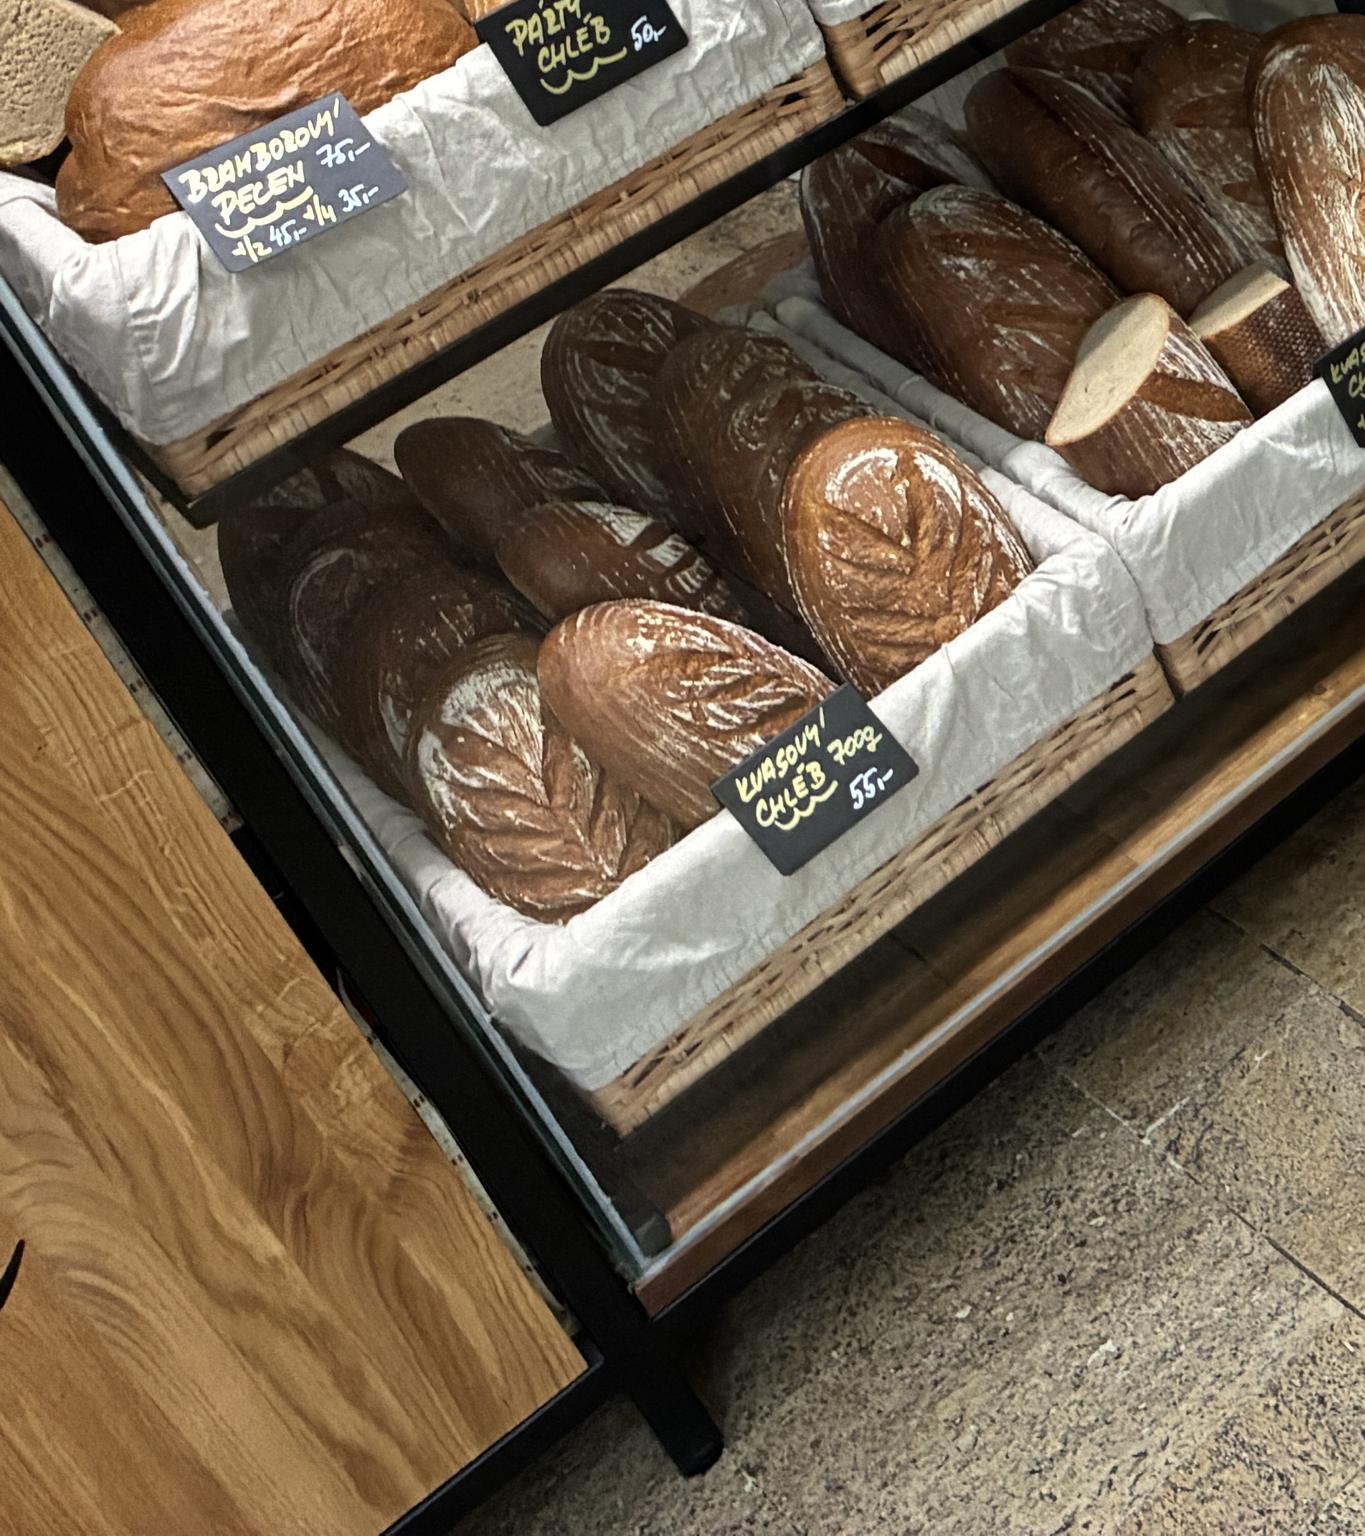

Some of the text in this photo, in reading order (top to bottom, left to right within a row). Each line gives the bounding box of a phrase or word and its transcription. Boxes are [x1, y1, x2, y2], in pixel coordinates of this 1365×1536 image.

[537, 12, 611, 74] CHLÉB
[630, 15, 667, 52] 50,-
[178, 97, 340, 204] BRAMBOROVÝ
[315, 138, 371, 168] 75,-
[232, 184, 379, 263] 1/2 45,- 1/4 35,-
[735, 706, 826, 803] KVASOVÝ
[755, 726, 884, 828] CHLÉB 700g
[849, 766, 894, 810] 55,-
